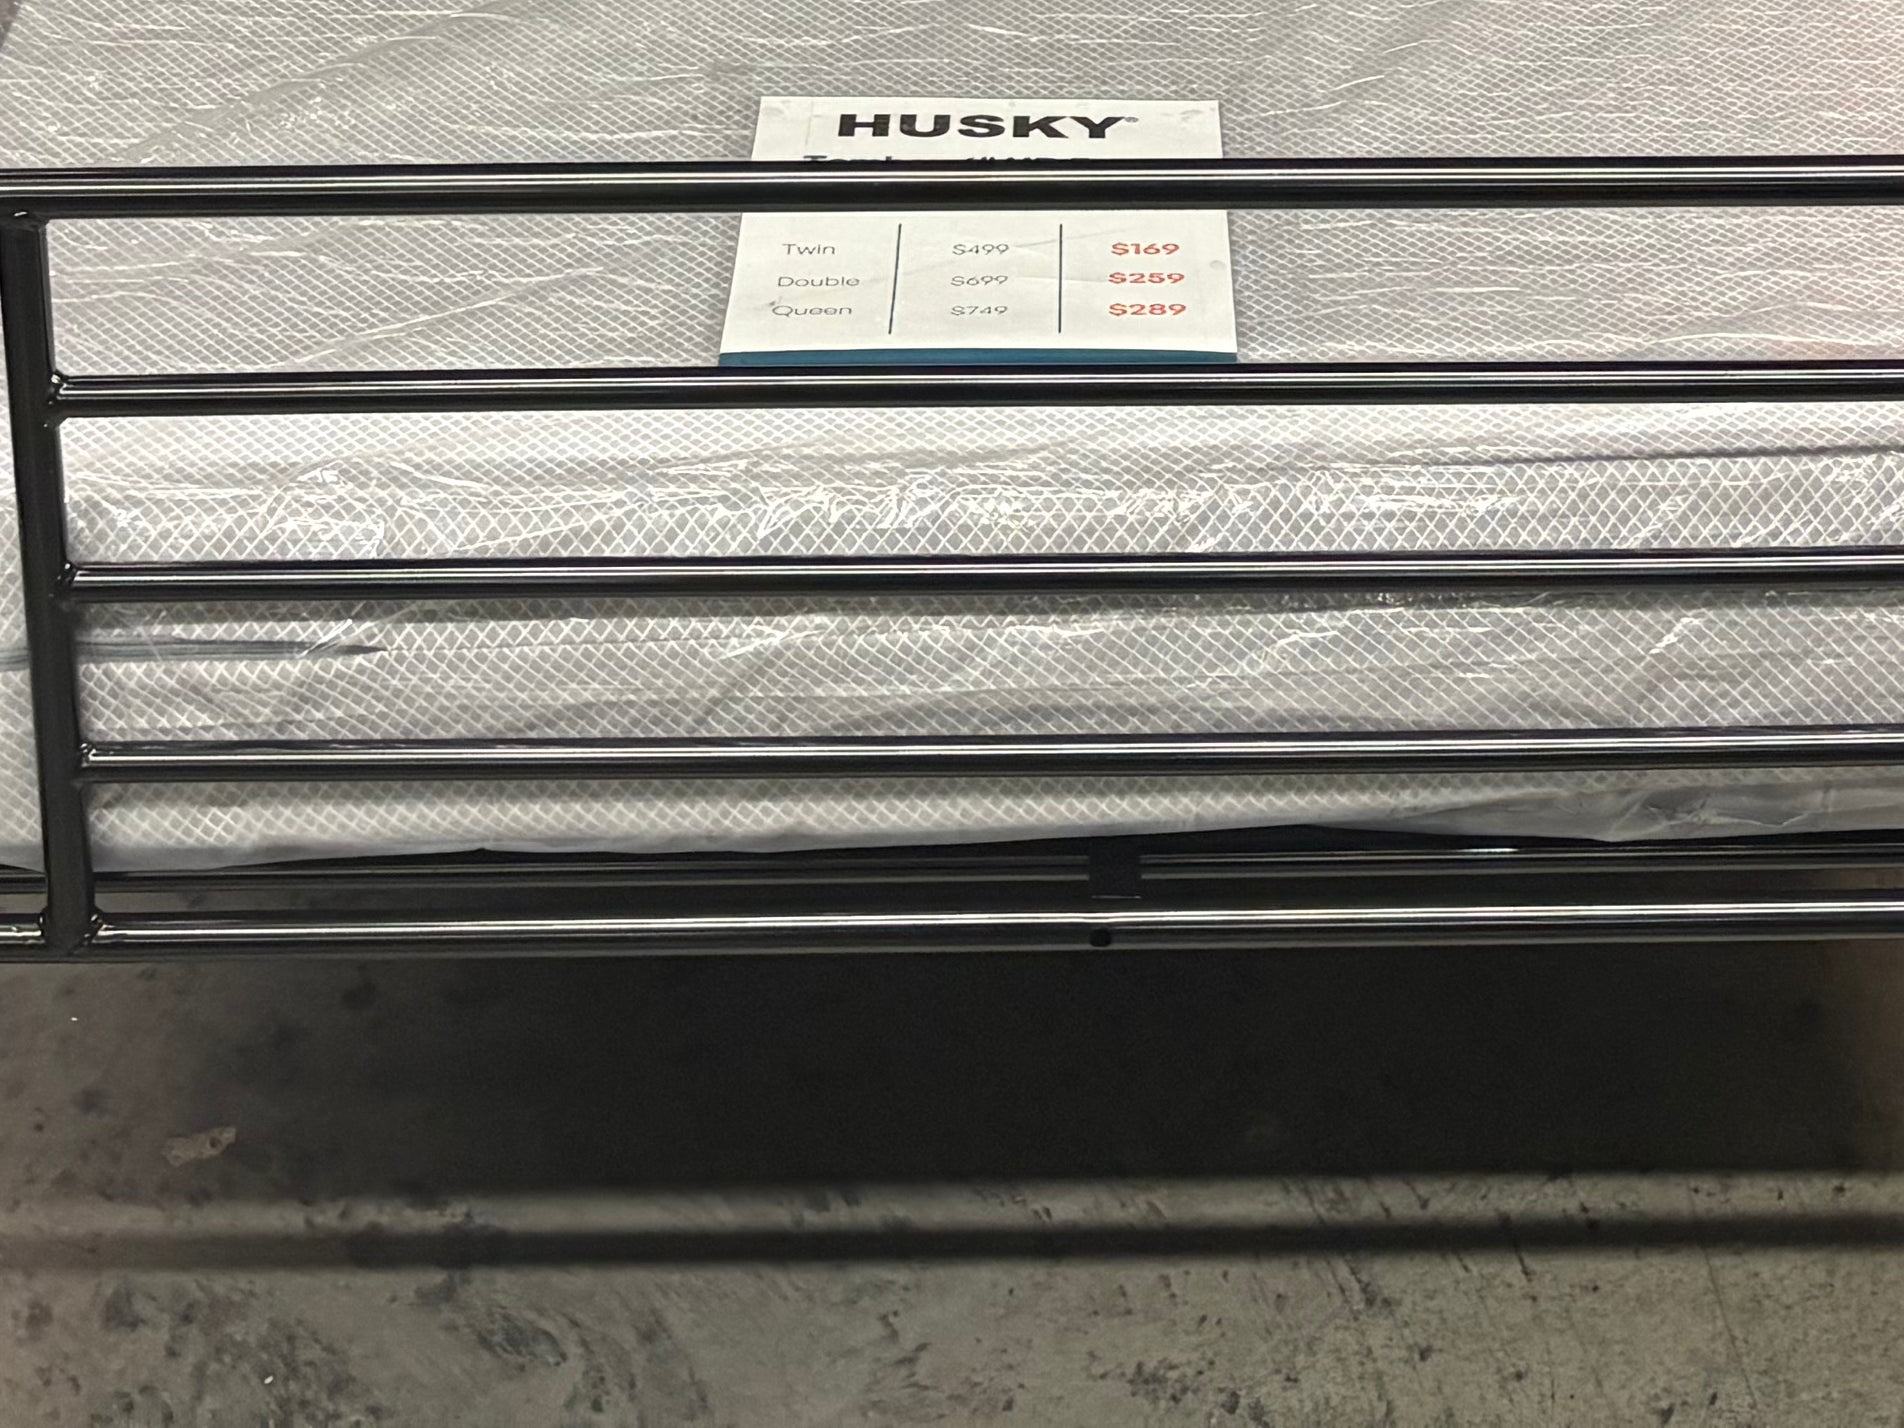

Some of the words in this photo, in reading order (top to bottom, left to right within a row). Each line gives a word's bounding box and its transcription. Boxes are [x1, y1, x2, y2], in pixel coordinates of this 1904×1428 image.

[838, 114, 1126, 139] HUSKY
[782, 243, 836, 256] Twin
[951, 243, 1010, 258] $499
[1110, 242, 1180, 258] $169
[777, 274, 861, 289] Double
[950, 273, 1009, 288] $699
[1108, 271, 1186, 287] $259
[771, 304, 853, 319] Queen
[1108, 302, 1187, 319] $289
